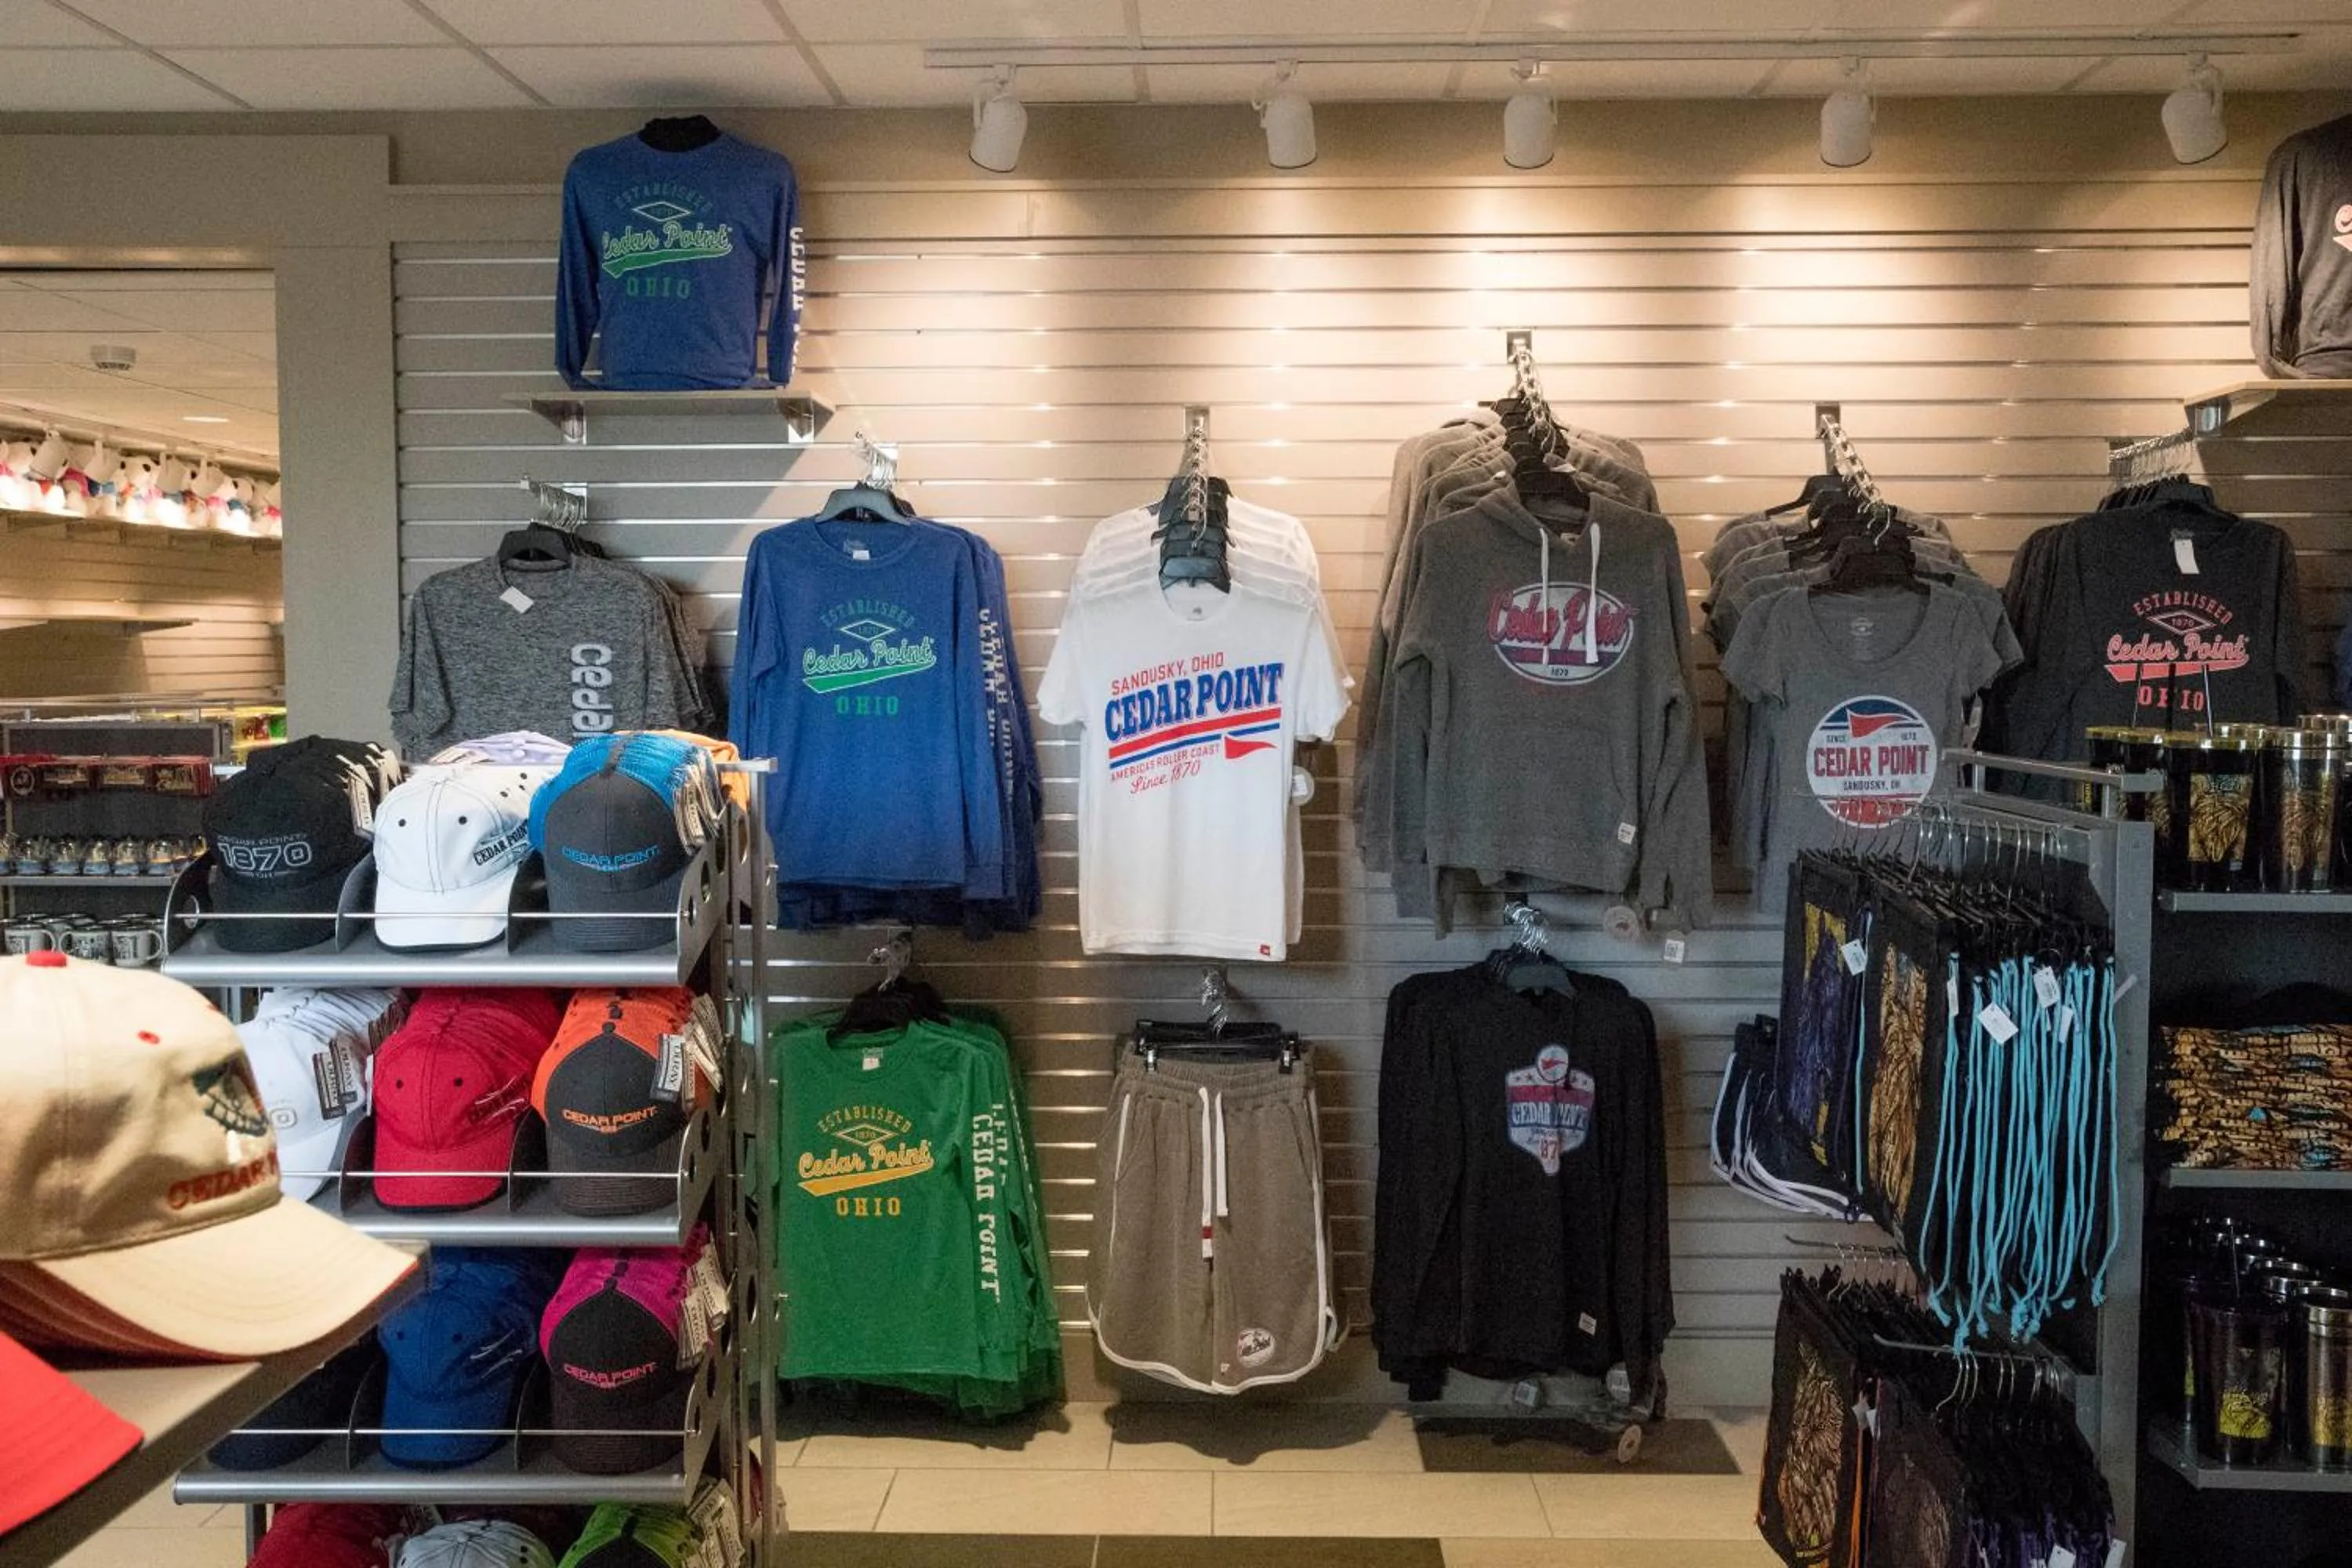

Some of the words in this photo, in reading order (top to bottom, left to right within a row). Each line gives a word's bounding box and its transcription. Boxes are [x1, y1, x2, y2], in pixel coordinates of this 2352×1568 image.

[662, 220, 729, 249] Point
[628, 277, 691, 299] OHIO
[820, 599, 915, 628] ESTABLISHED
[2132, 590, 2233, 625] ESTABLISHED
[802, 644, 869, 675] Cedar
[870, 636, 932, 666] Point
[2107, 633, 2179, 662] Cedar
[2183, 632, 2247, 661] Point
[1111, 659, 1187, 696] SANDUSKY,
[1191, 651, 1225, 673] OHIO
[571, 644, 614, 738] Ceda
[835, 695, 898, 716] OHIO
[1104, 679, 1192, 742] CEDAR
[1196, 662, 1284, 717] POINT
[1156, 750, 1189, 767] ROLLER
[1189, 742, 1220, 759] COAST
[1813, 746, 1871, 777] CEDAR
[1878, 744, 1929, 775] POINT
[1130, 775, 1167, 794] Since
[1171, 759, 1202, 785] 1870
[1843, 780, 1889, 791] SANDUSKY,
[217, 841, 312, 872] 1870
[473, 840, 508, 866] CEDAR
[562, 845, 612, 866] CEDAR
[614, 844, 658, 866] POINT
[563, 1109, 611, 1127] CEDAR
[612, 1105, 657, 1127] POINT
[818, 1105, 913, 1134] ESTABLISHED
[1511, 1101, 1551, 1126] CEDAR
[797, 1148, 866, 1179] Cedar
[868, 1139, 931, 1171] Point
[972, 1113, 996, 1202] CEDAR
[167, 1159, 267, 1210] CEDAR
[836, 1196, 902, 1217] OHIO
[564, 1363, 609, 1385] CEDAR
[611, 1361, 657, 1383] POINT
